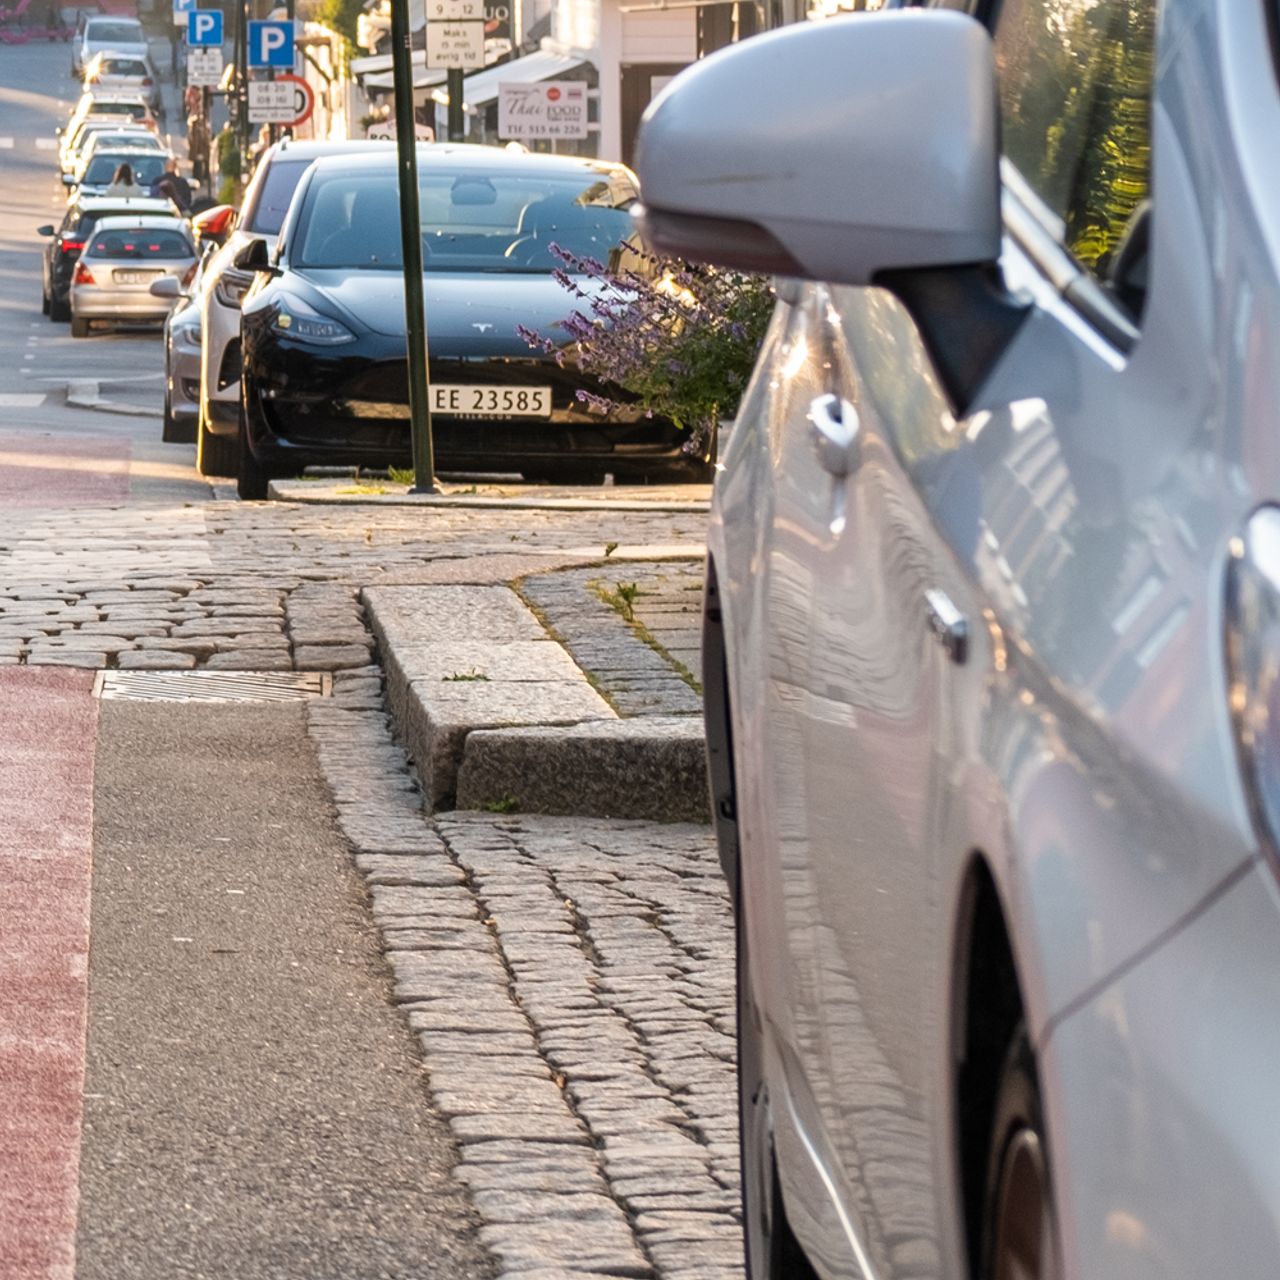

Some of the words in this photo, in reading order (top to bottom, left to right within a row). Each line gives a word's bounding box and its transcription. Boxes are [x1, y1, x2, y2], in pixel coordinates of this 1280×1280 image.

[196, 16, 214, 41] P
[261, 27, 285, 62] P
[436, 389, 459, 409] EE
[472, 389, 543, 411] 23585
